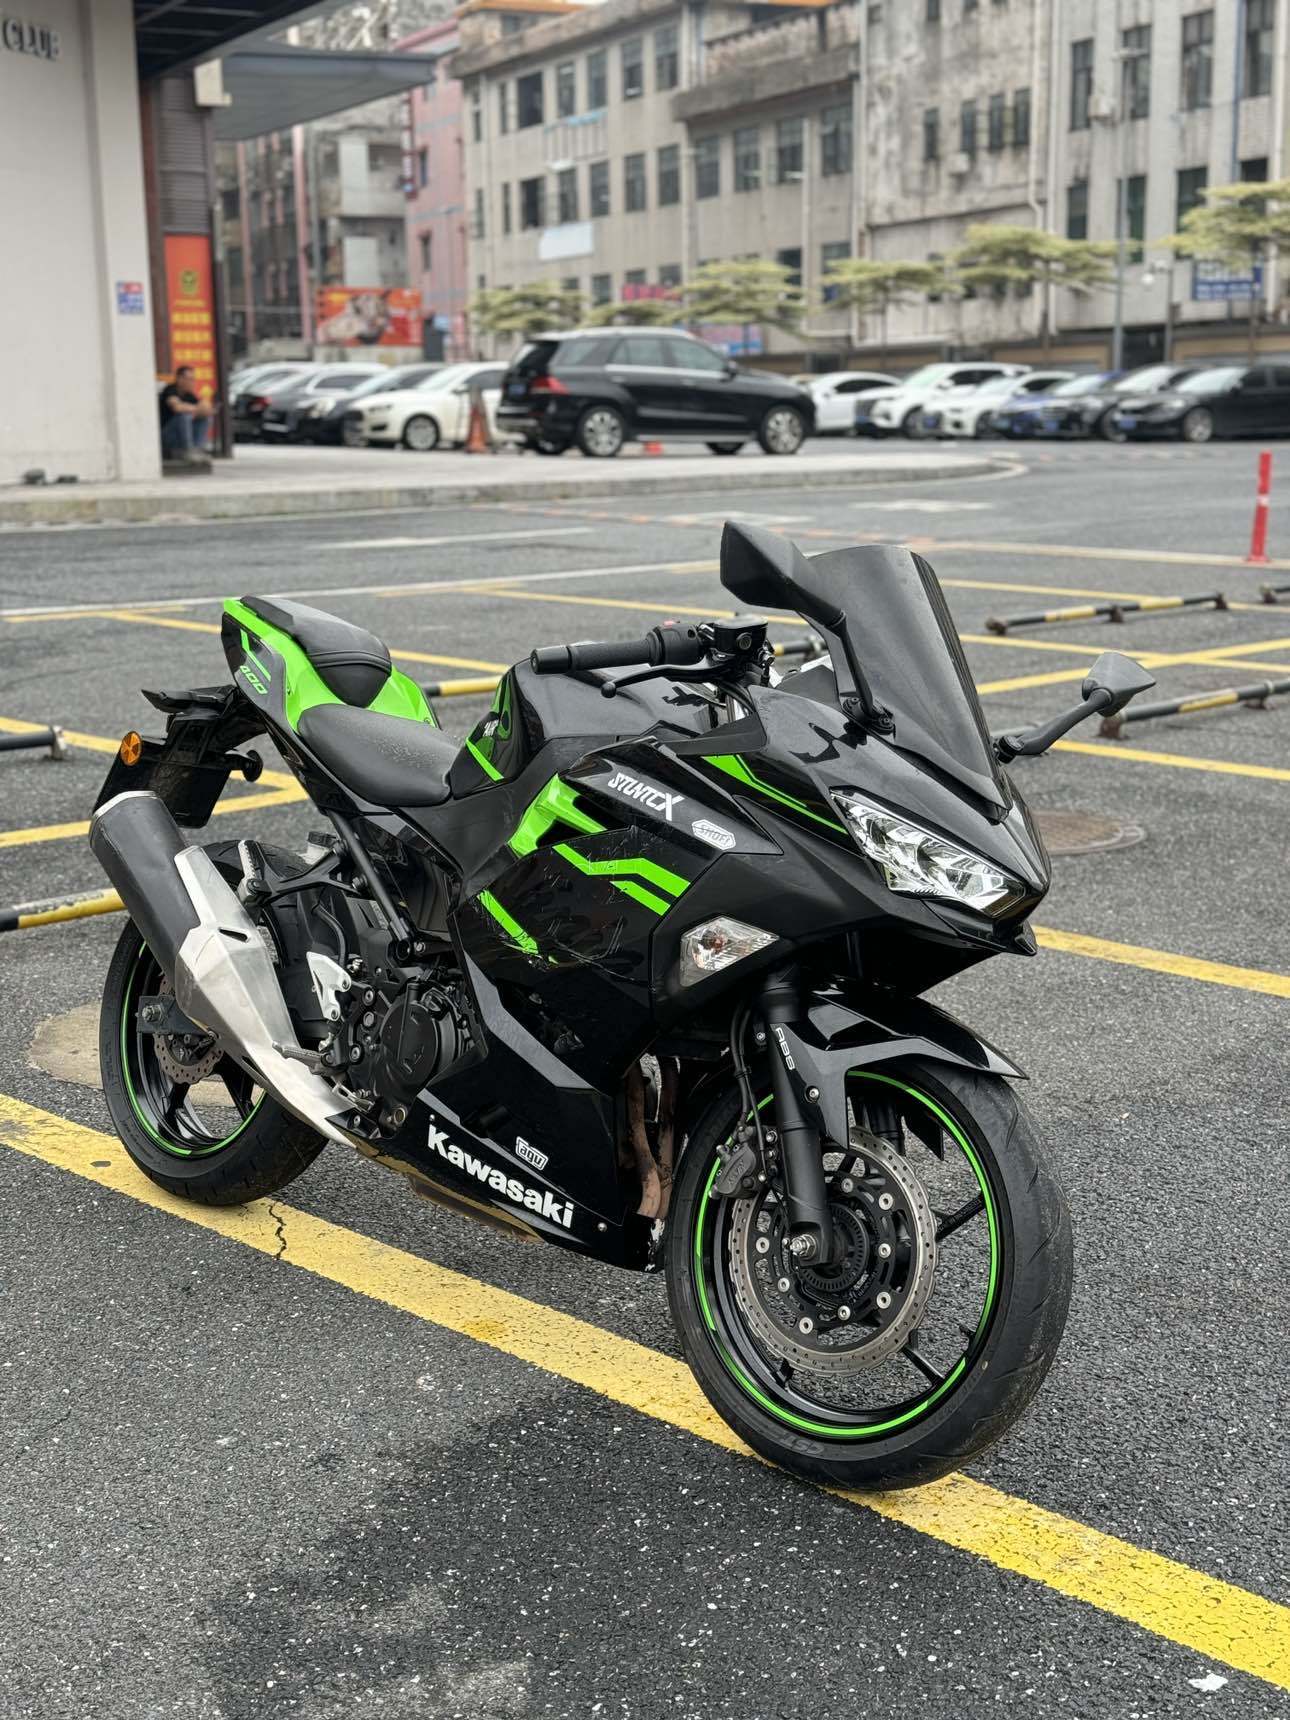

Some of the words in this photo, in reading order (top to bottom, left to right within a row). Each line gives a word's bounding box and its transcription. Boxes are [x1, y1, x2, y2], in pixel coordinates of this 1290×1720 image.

[2, 19, 62, 61] CLUB
[240, 665, 268, 695] 400
[775, 1027, 796, 1070] ABS
[428, 1124, 575, 1228] Kawasaki
